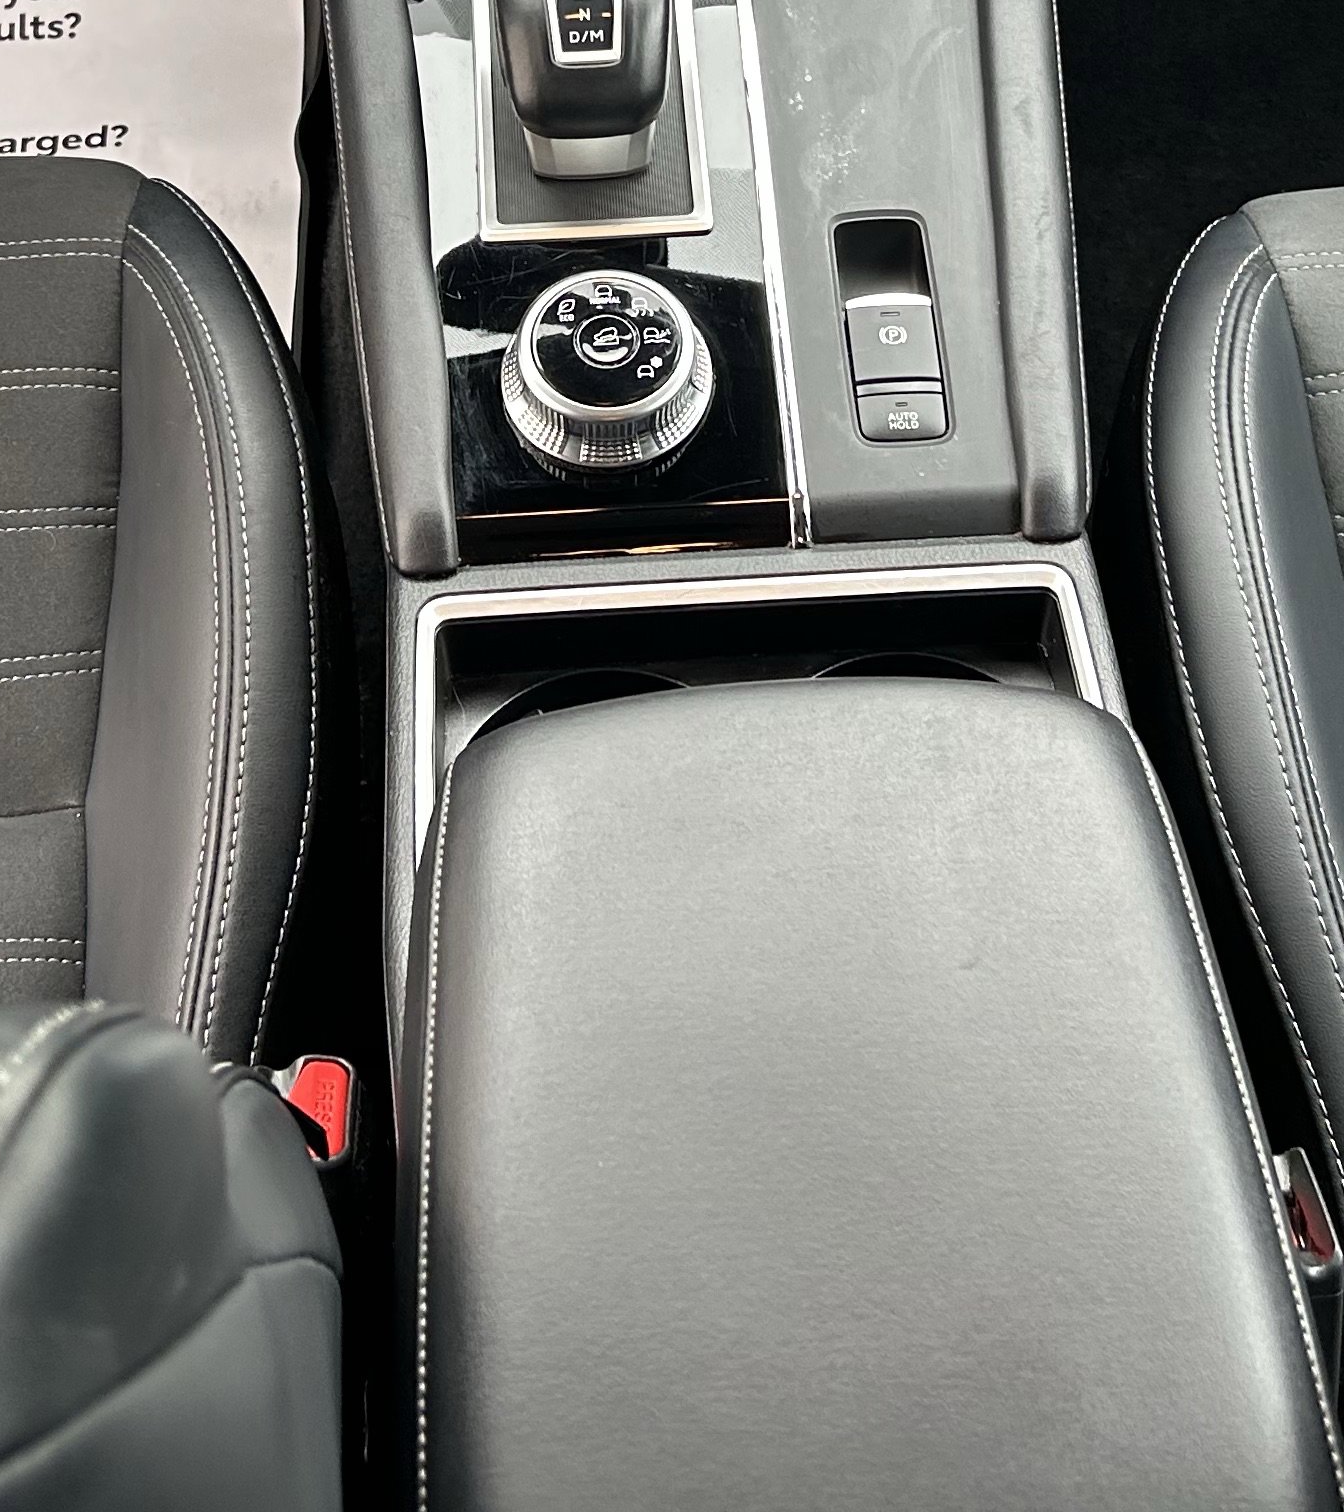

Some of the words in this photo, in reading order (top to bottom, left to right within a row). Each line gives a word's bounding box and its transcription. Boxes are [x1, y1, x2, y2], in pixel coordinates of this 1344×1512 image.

[578, 7, 591, 21] N
[568, 29, 605, 44] D/M
[559, 314, 574, 322] ECO
[888, 411, 918, 422] AUTO
[889, 420, 919, 430] HOLD
